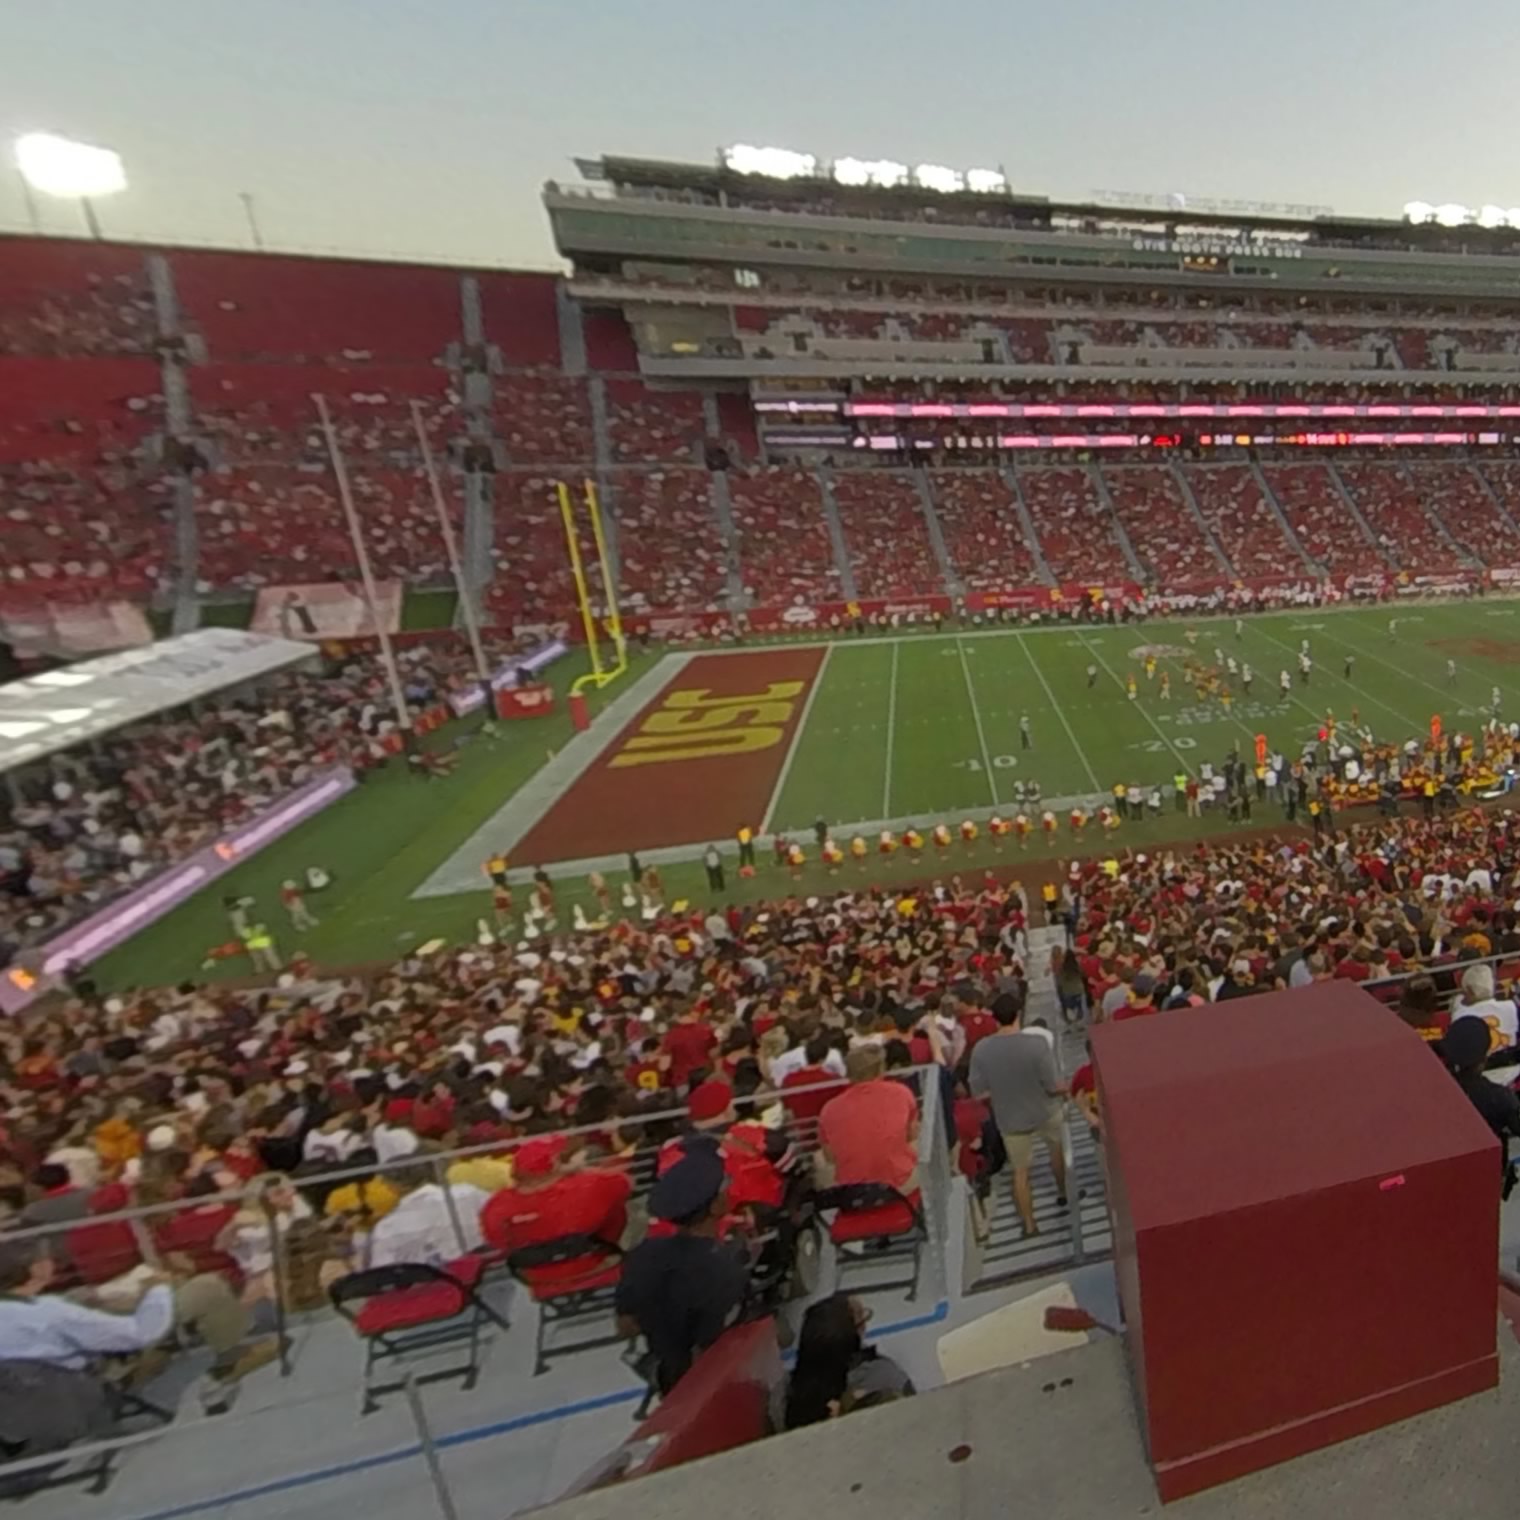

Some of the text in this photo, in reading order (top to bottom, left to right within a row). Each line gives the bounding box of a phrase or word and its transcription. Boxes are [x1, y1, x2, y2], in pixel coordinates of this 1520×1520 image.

[606, 681, 804, 768] USC
[1141, 736, 1197, 752] 20
[965, 754, 1018, 772] 10
